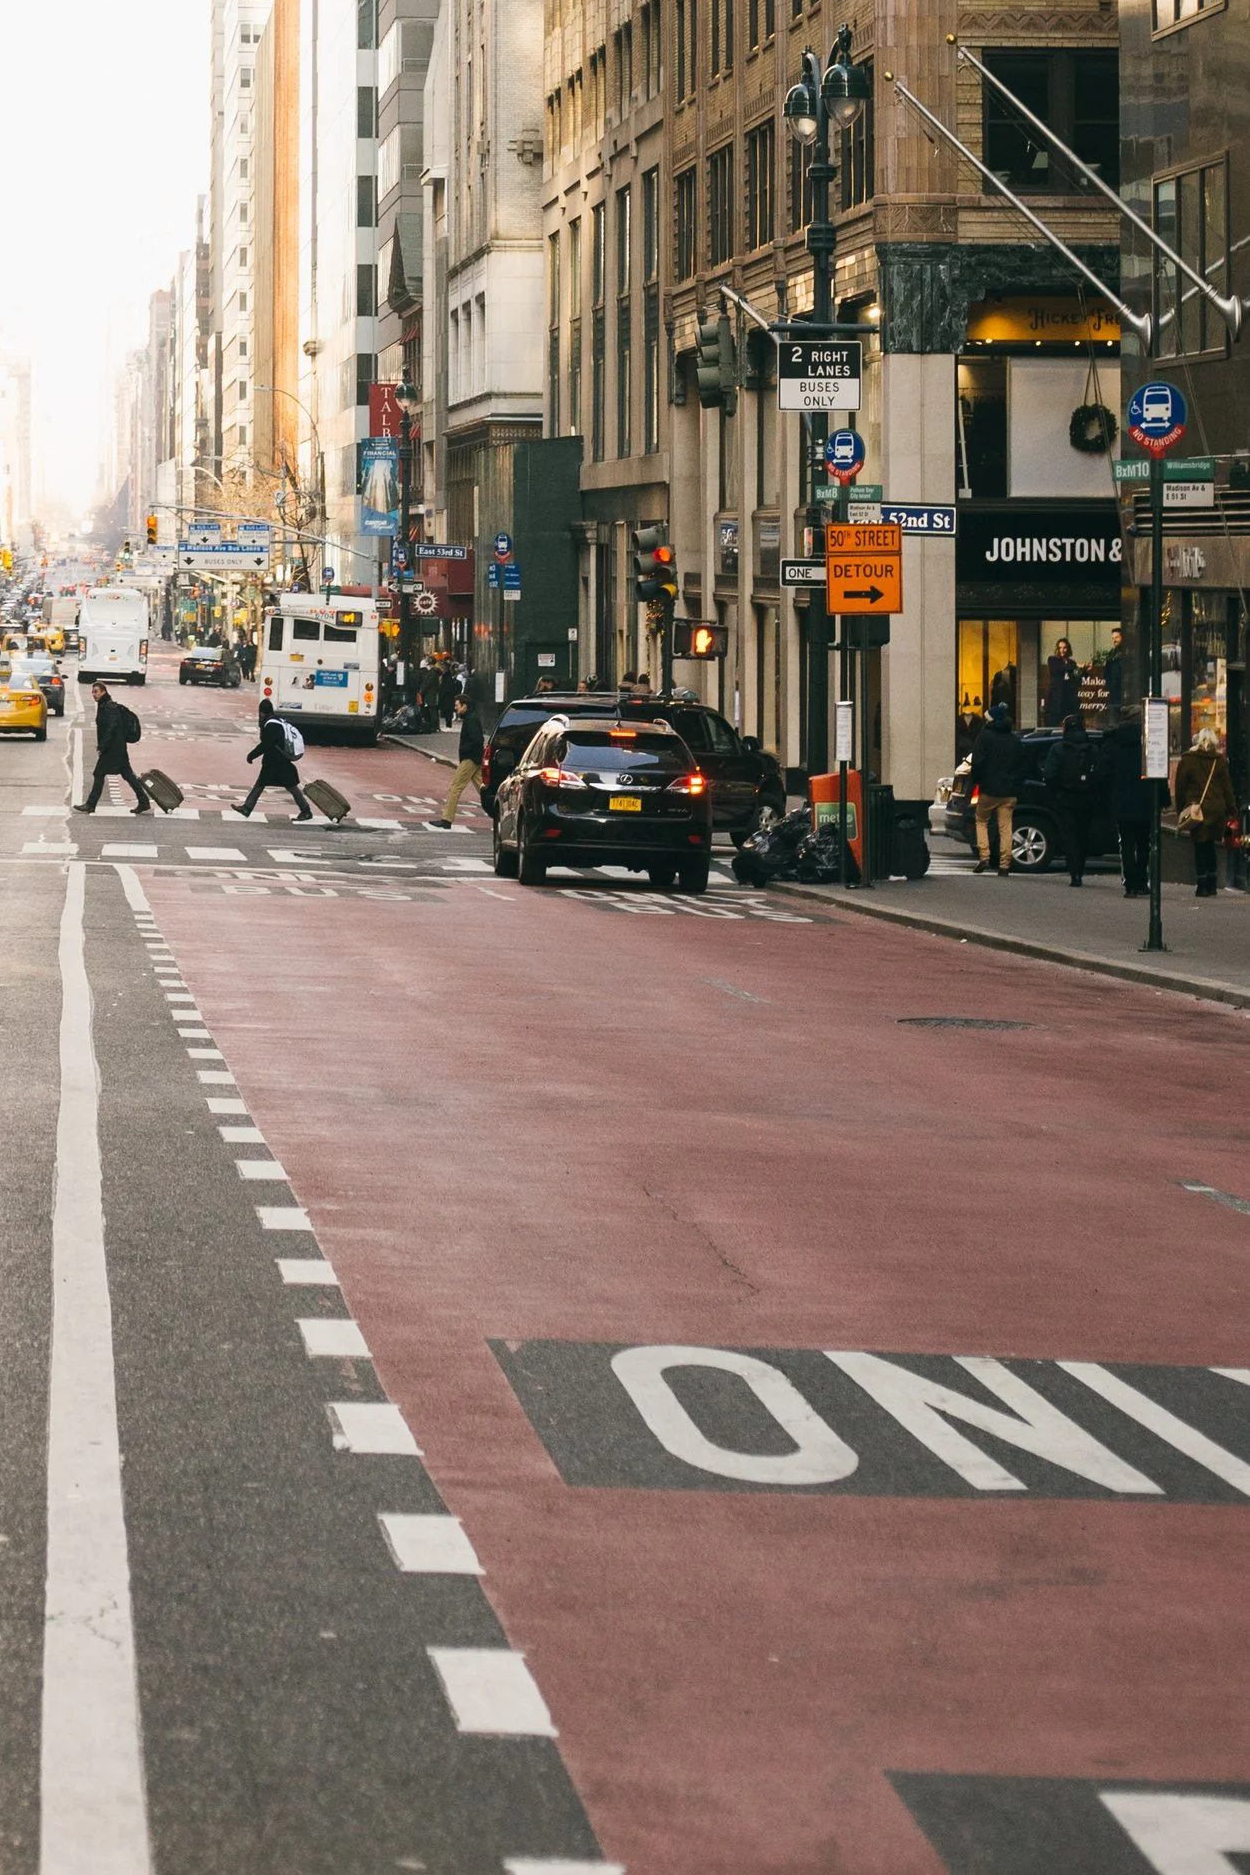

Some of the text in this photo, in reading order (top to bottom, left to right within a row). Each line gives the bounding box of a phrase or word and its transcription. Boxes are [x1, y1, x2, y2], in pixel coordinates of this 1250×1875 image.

[791, 346, 849, 362] 2 RIGHT
[808, 365, 851, 377] LANES
[799, 381, 840, 393] BUSES
[803, 395, 835, 406] ONLY
[1132, 428, 1182, 447] NO STANDING
[1115, 462, 1150, 478] BxM10
[816, 488, 838, 499] BxM8
[1166, 484, 1191, 492] Madison
[1191, 484, 1200, 492] Av
[888, 512, 930, 528] 52nd
[932, 512, 951, 529] St
[855, 530, 896, 547] STREET
[418, 546, 464, 557] East 53rd St
[985, 537, 1105, 562] JOHNSTON
[788, 568, 813, 579] ONE
[833, 564, 895, 579] DETOUR
[1081, 676, 1107, 686] Make
[1077, 688, 1110, 698] way for
[1079, 702, 1108, 713] merry.
[221, 884, 413, 901] BUS
